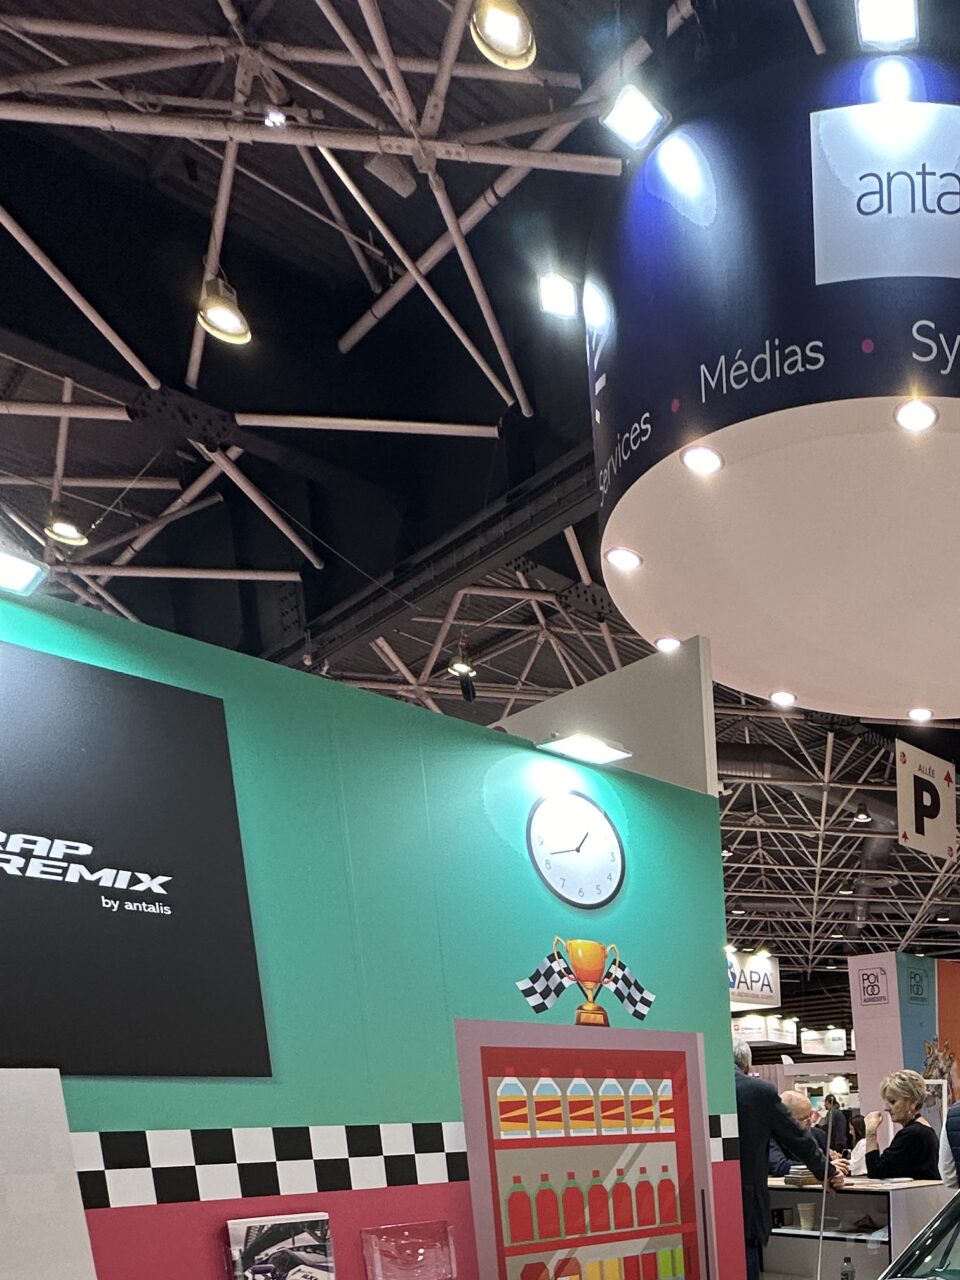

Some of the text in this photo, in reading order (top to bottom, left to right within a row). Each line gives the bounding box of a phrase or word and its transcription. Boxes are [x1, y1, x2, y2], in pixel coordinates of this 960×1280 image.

[700, 338, 826, 404] Médias
[599, 412, 652, 507] Services
[918, 764, 936, 779] ALLÉE
[913, 774, 941, 836] P
[0, 853, 173, 894] REMIX
[101, 895, 172, 915] by antalis
[737, 969, 774, 993] APA
